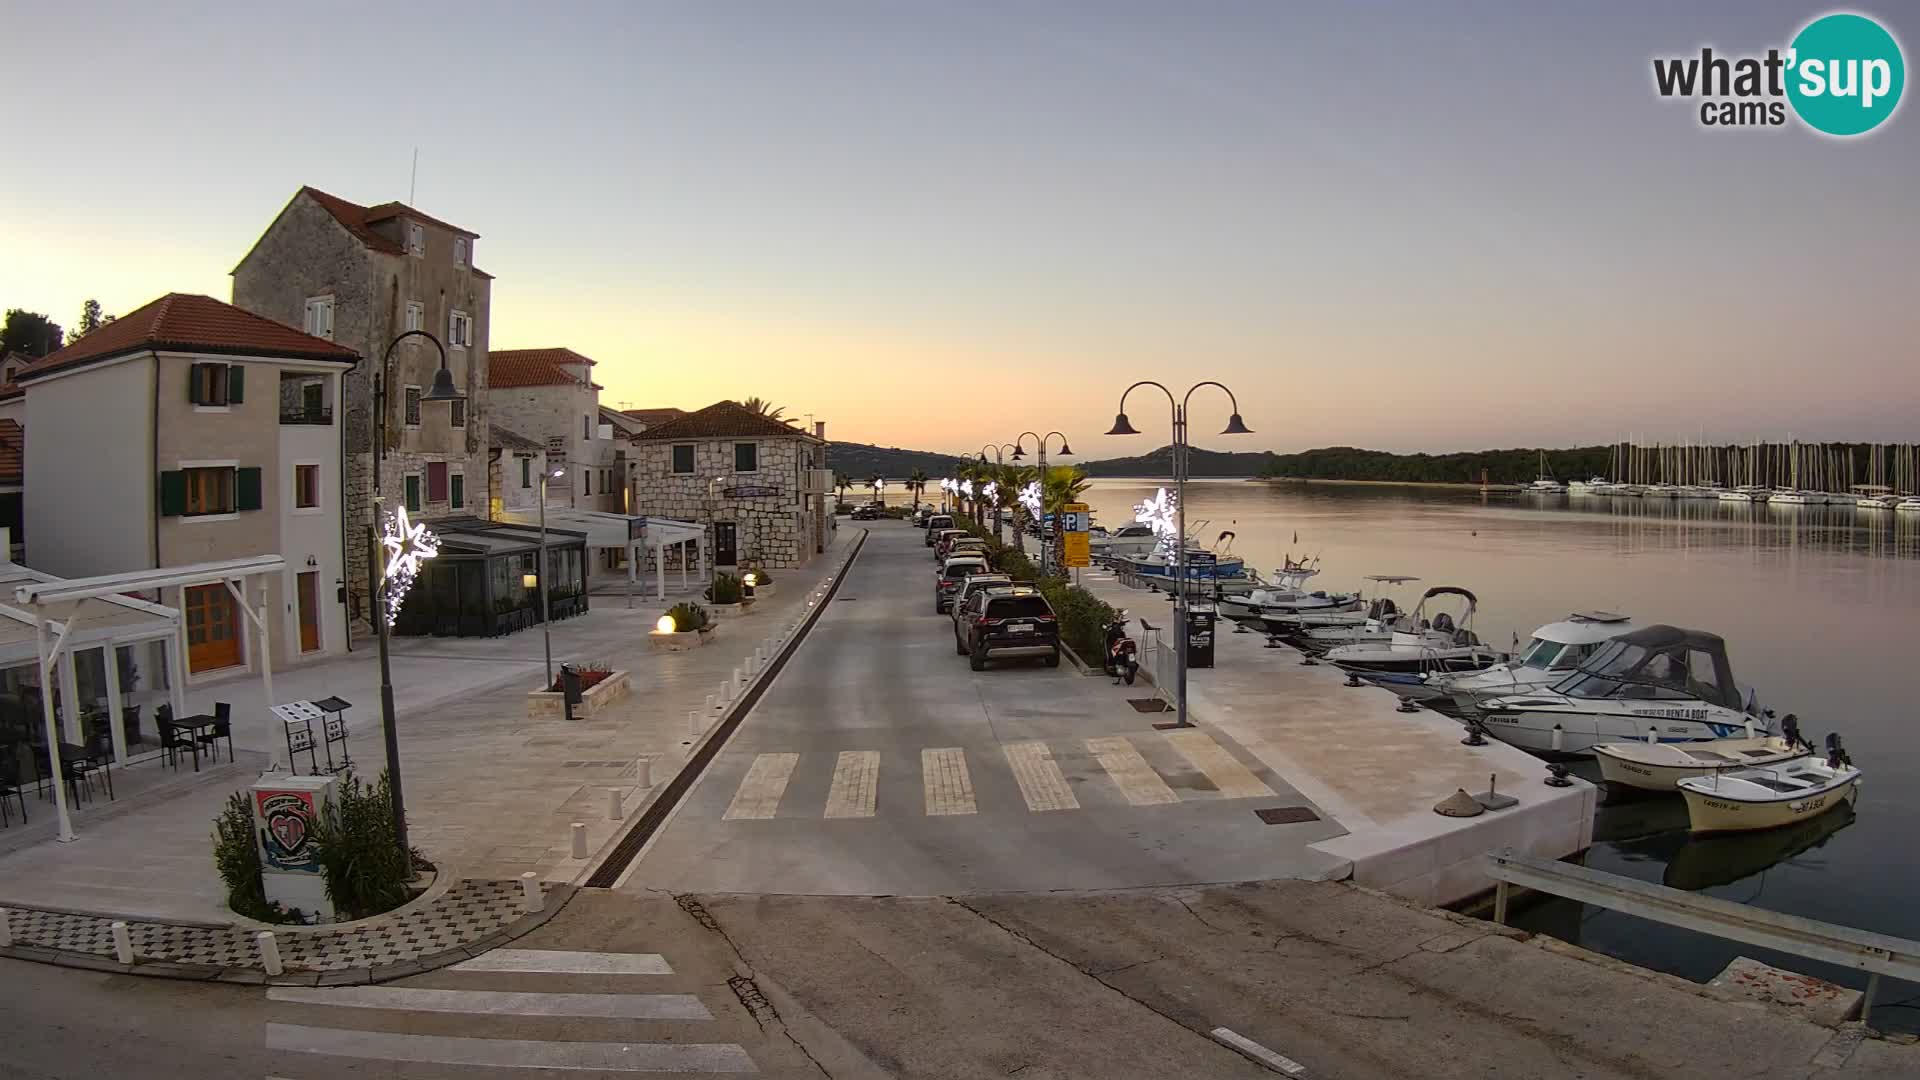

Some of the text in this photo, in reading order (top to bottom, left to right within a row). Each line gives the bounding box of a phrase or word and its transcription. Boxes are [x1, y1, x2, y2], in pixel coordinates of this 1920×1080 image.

[1066, 514, 1077, 530] P
[1666, 709, 1685, 719] RENT
[1685, 710, 1690, 719] A
[1691, 710, 1709, 720] BOAT
